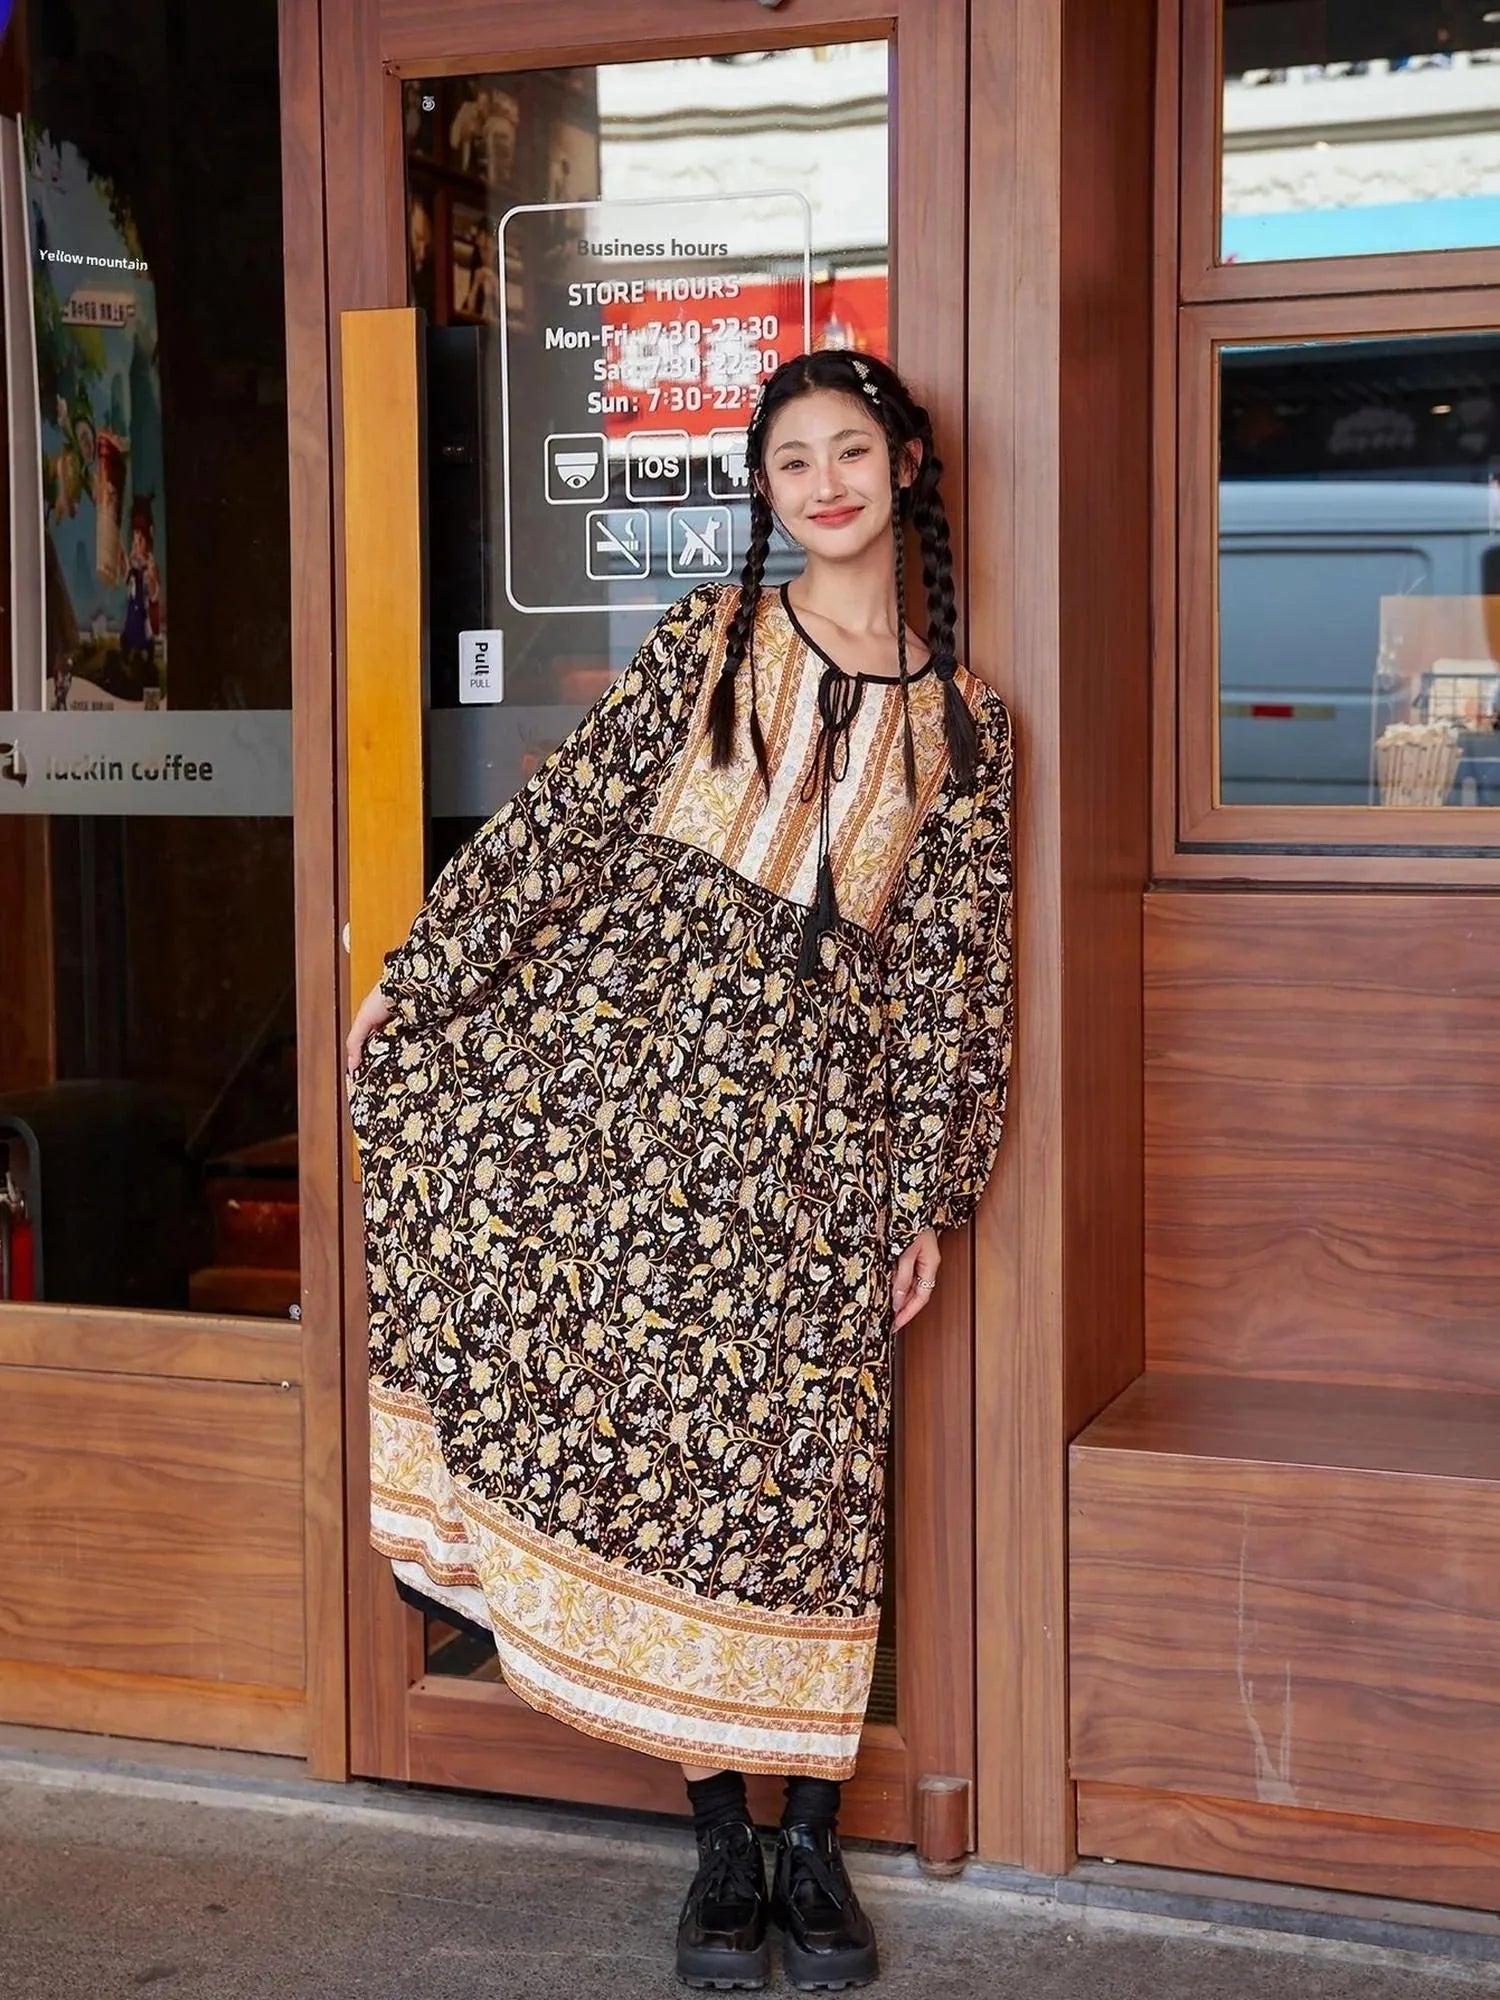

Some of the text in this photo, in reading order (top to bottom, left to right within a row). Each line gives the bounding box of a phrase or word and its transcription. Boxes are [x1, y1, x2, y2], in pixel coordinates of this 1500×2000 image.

[577, 238, 728, 256] Business hours
[39, 249, 148, 271] Yellow mountain
[568, 275, 740, 307] STORE HOURS
[588, 384, 761, 414] Sun: 7:30-22:3
[638, 456, 680, 478] iOS
[475, 642, 490, 675] Pull
[470, 679, 490, 688] PULL
[132, 754, 213, 781] coffee
